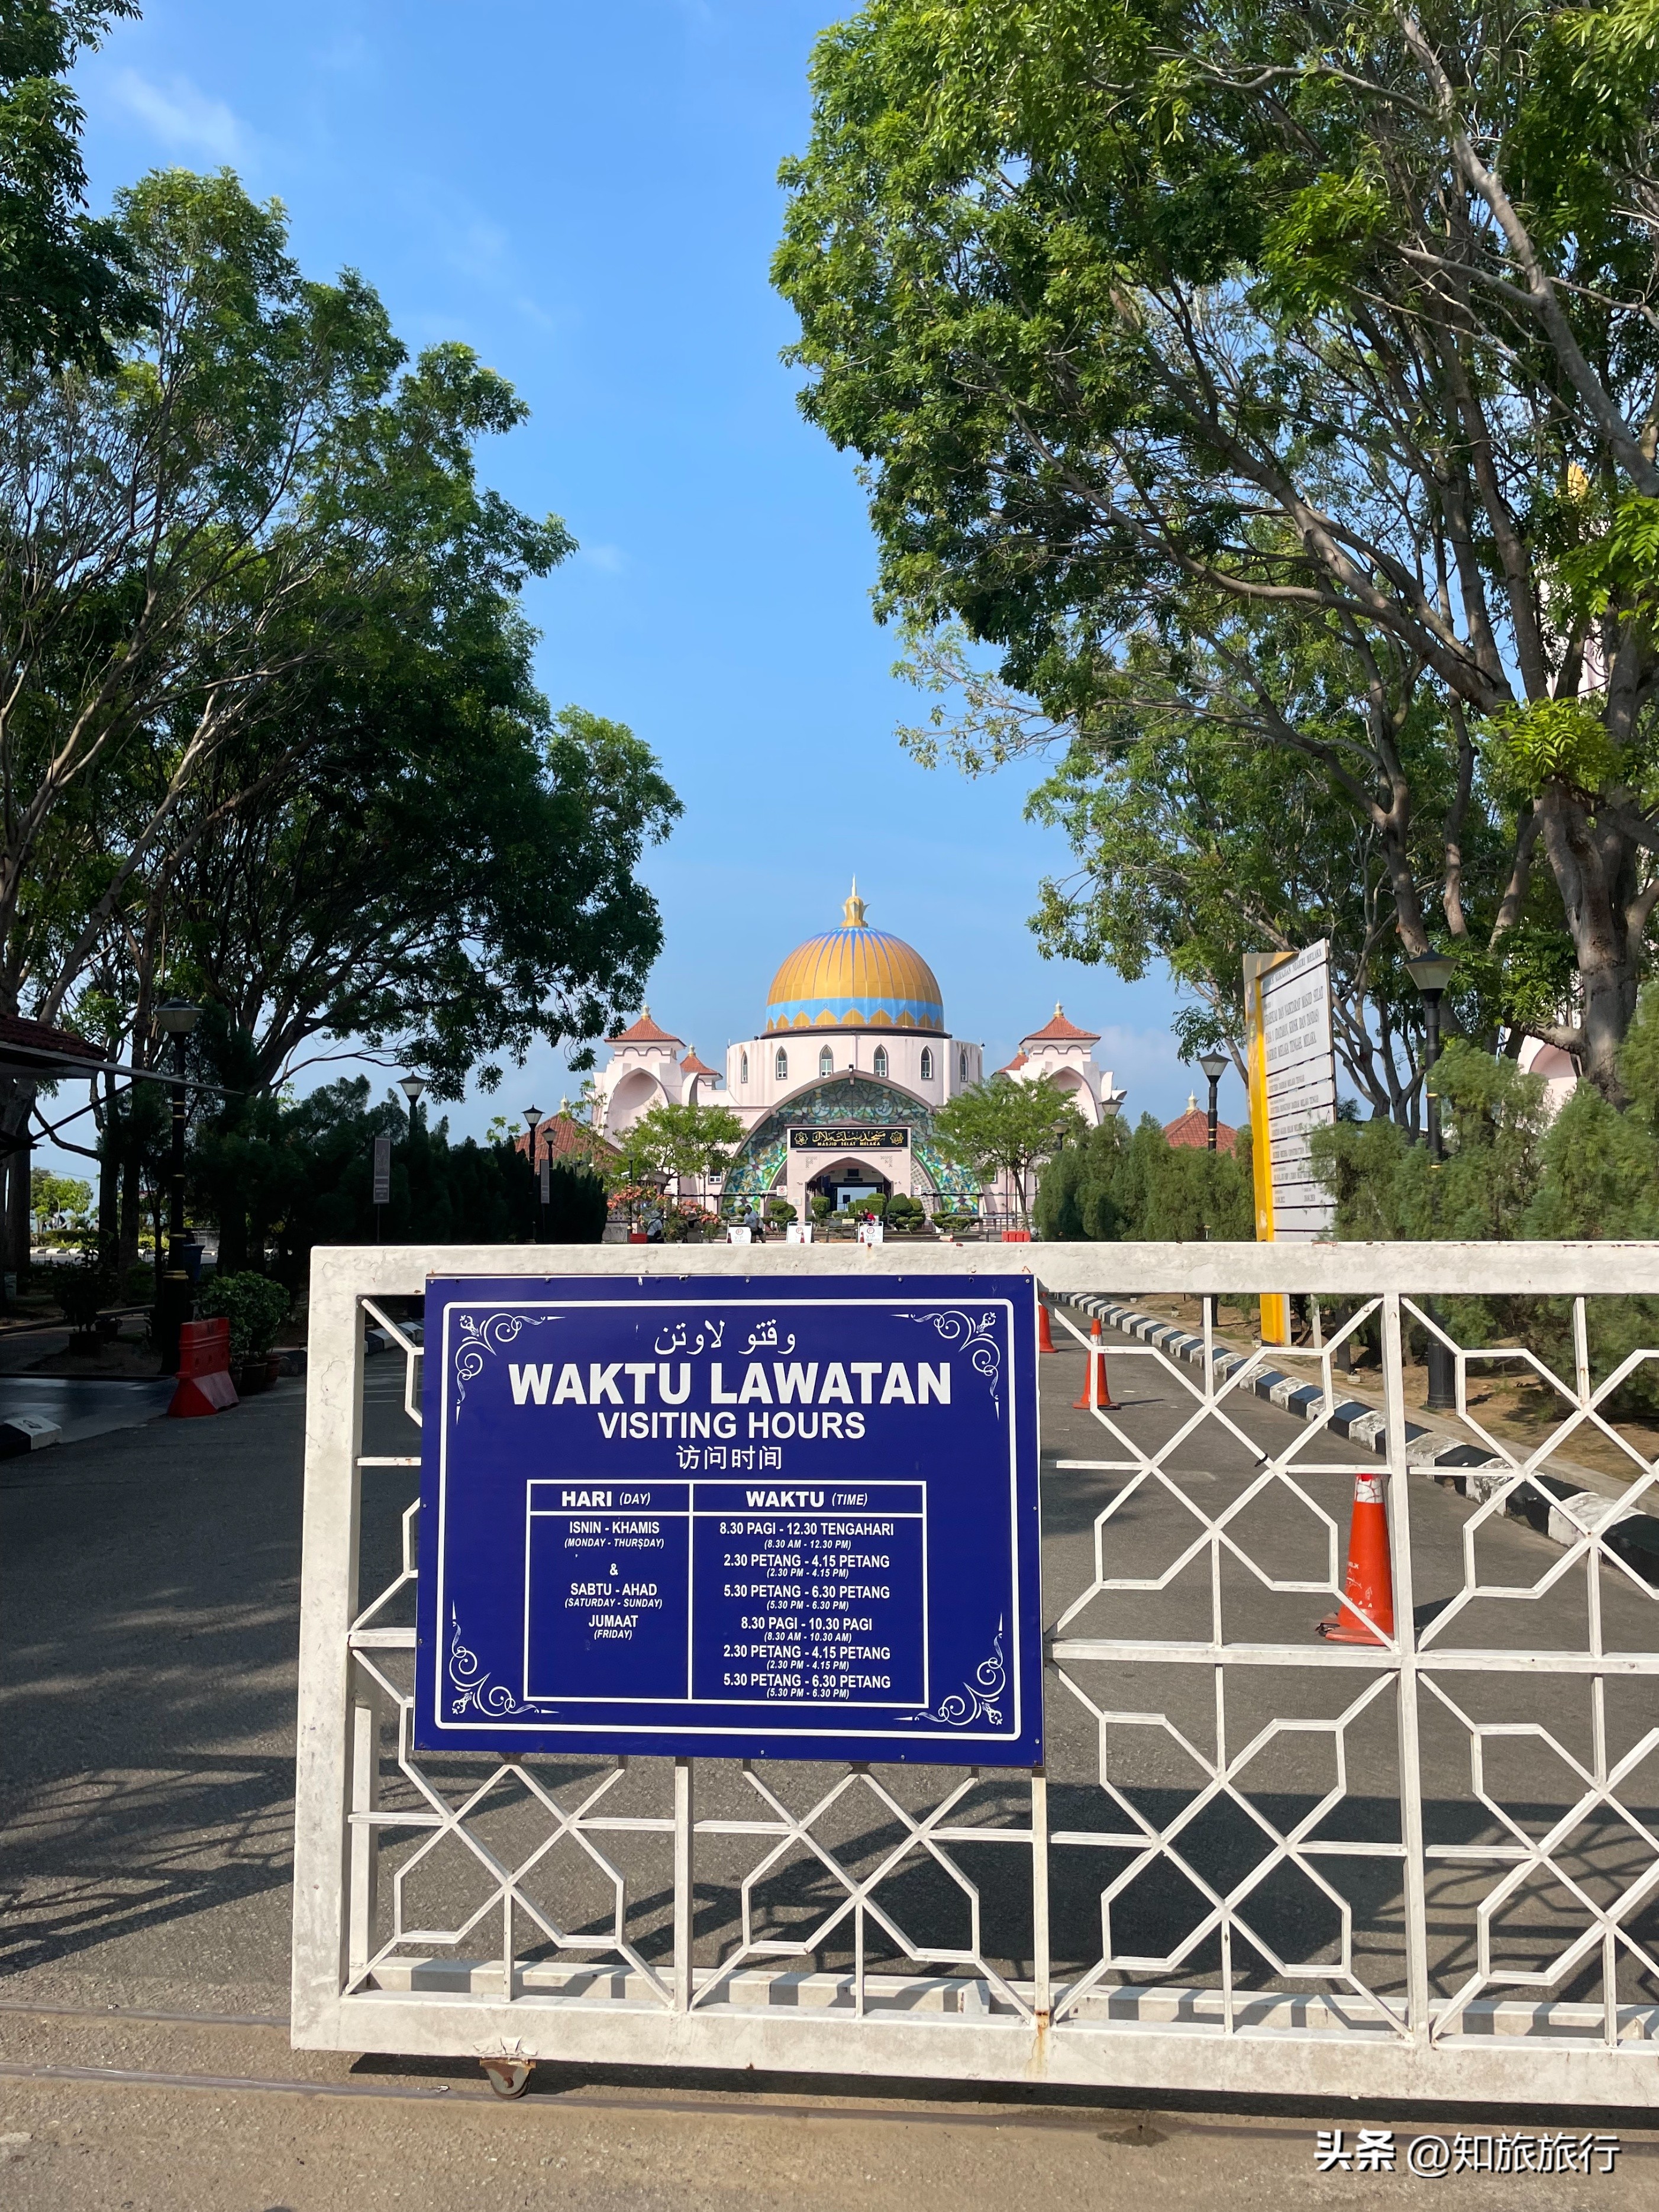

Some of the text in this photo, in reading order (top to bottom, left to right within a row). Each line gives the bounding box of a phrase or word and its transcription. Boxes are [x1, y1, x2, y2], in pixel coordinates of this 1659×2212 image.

[509, 1363, 950, 1404] WAKTU LAWATAN
[598, 1412, 865, 1439] VISITING HOURS
[676, 1445, 781, 1469] 访问时间
[562, 1491, 650, 1507] HARI (DAY)
[746, 1491, 867, 1507] WAKTU (TIME)
[570, 1521, 601, 1533] ISNIN
[612, 1521, 659, 1533] KHAMIS
[720, 1522, 743, 1534] 8.30
[747, 1523, 775, 1534] PAGI
[787, 1523, 817, 1534] 12.30
[821, 1523, 893, 1535] TENGAHARI
[565, 1539, 606, 1548] (MONDAY
[614, 1539, 664, 1549] THURSDAY)
[764, 1540, 785, 1550] (8.30
[787, 1540, 801, 1548] AM
[811, 1540, 832, 1548] 12.30
[835, 1540, 851, 1550] PM)
[724, 1554, 747, 1566] 2.30
[751, 1554, 801, 1566] PETANG
[812, 1555, 835, 1567] 4.15
[840, 1555, 889, 1568] PETANG
[610, 1563, 618, 1575] &
[767, 1568, 787, 1578] (2.30
[790, 1568, 803, 1576] PM
[812, 1569, 830, 1577] 4.15
[832, 1569, 848, 1579] PM)
[571, 1583, 611, 1595] SABTU
[622, 1584, 657, 1595] AHAD
[724, 1585, 747, 1597] 5.30
[751, 1585, 801, 1597] PETANG
[812, 1586, 835, 1598] 6.30
[840, 1586, 889, 1598] PETANG
[565, 1598, 615, 1608] (SATURDAY
[624, 1598, 662, 1609] SUNDAY)
[767, 1601, 787, 1610] (5.30
[790, 1601, 803, 1609] PM
[812, 1601, 830, 1609] 6.30
[833, 1601, 848, 1611] PM)
[589, 1615, 638, 1627] JUMAAT
[741, 1617, 764, 1629] 8.30
[769, 1617, 797, 1629] PAGI
[809, 1618, 839, 1630] 10.30
[844, 1618, 872, 1630] PAGI
[595, 1630, 632, 1640] (FRIDAY)
[764, 1632, 785, 1642] (8.30
[787, 1632, 801, 1640] AM
[811, 1633, 832, 1641] 10.30
[835, 1633, 851, 1643] AM)
[724, 1645, 747, 1657] 2.30
[751, 1645, 801, 1658] PETANG
[812, 1646, 836, 1658] 4.15
[840, 1646, 890, 1659] PETANG
[767, 1660, 787, 1671] (2.30
[790, 1660, 803, 1669] PM
[812, 1661, 830, 1669] 4.15
[833, 1661, 849, 1672] PM)
[724, 1673, 747, 1685] 5.30
[751, 1673, 801, 1687] PETANG
[812, 1675, 835, 1687] 6.30
[840, 1675, 890, 1688] PETANG
[767, 1688, 787, 1698] (5.30
[790, 1688, 803, 1697] PM
[813, 1689, 830, 1697] 6.30
[833, 1689, 849, 1700] PM)
